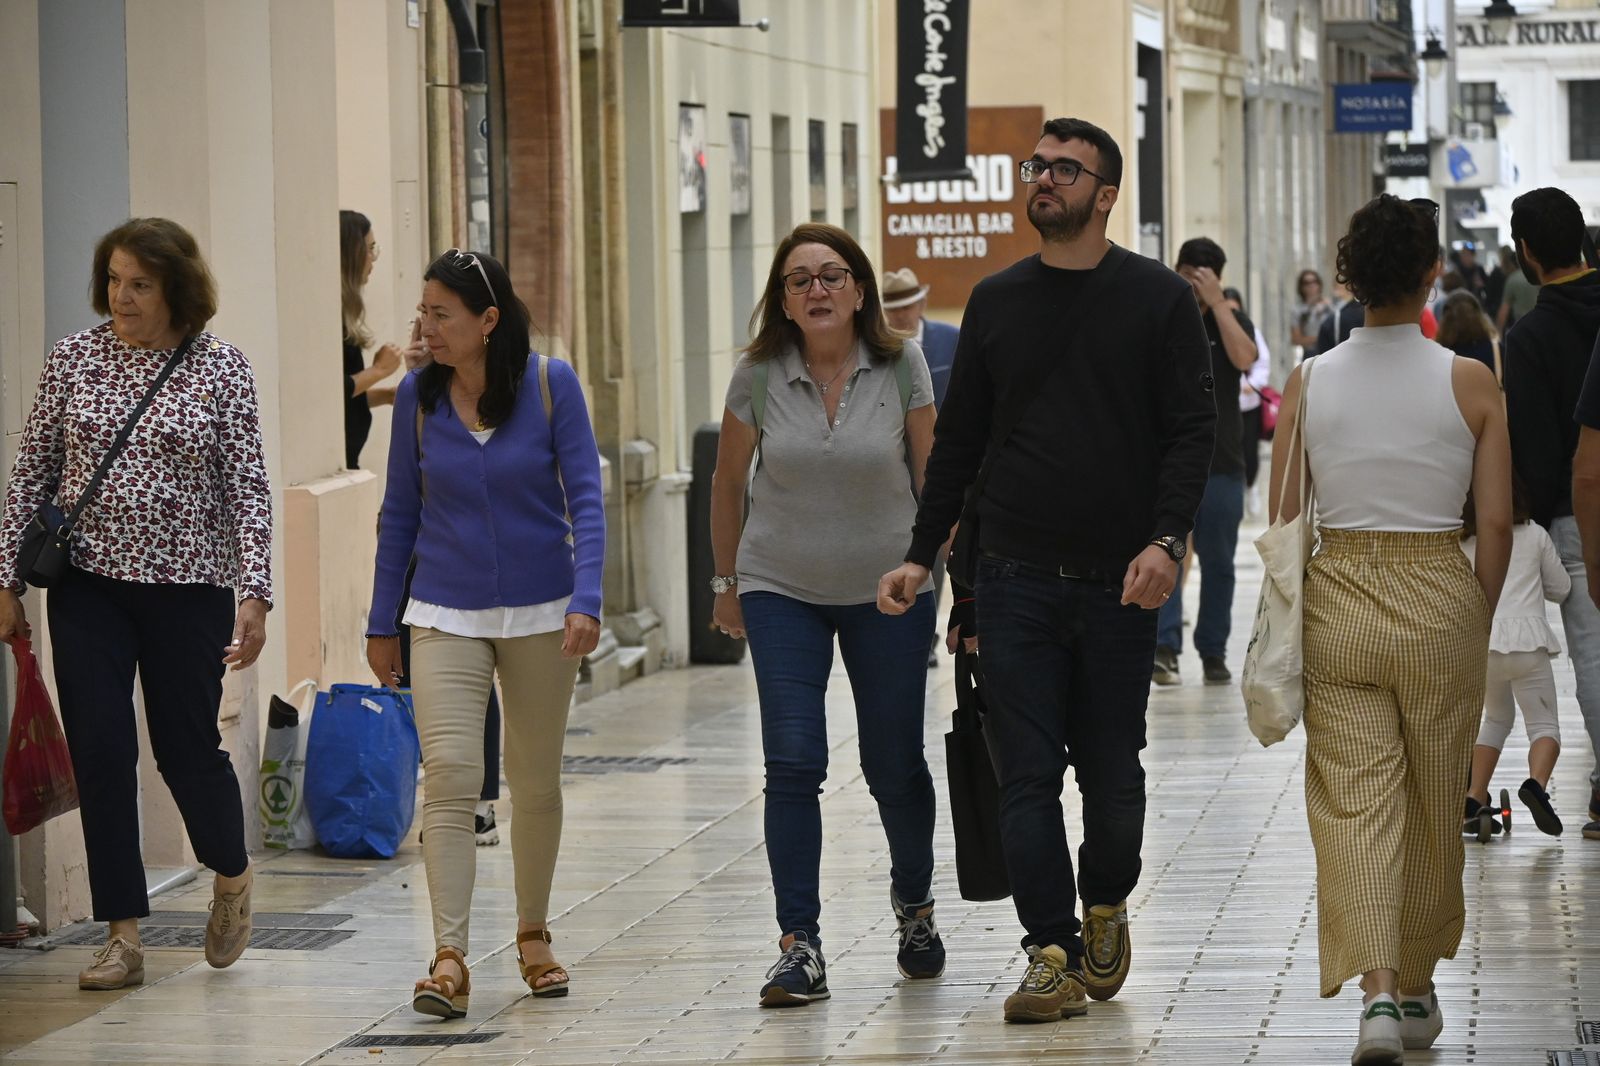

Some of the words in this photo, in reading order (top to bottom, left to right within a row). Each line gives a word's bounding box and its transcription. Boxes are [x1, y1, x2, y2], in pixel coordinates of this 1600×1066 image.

[1516, 20, 1600, 45] RURAL
[887, 213, 975, 237] CANAGLIA
[977, 212, 1015, 234] BAR
[916, 237, 930, 259] &
[931, 235, 988, 259] RESTO
